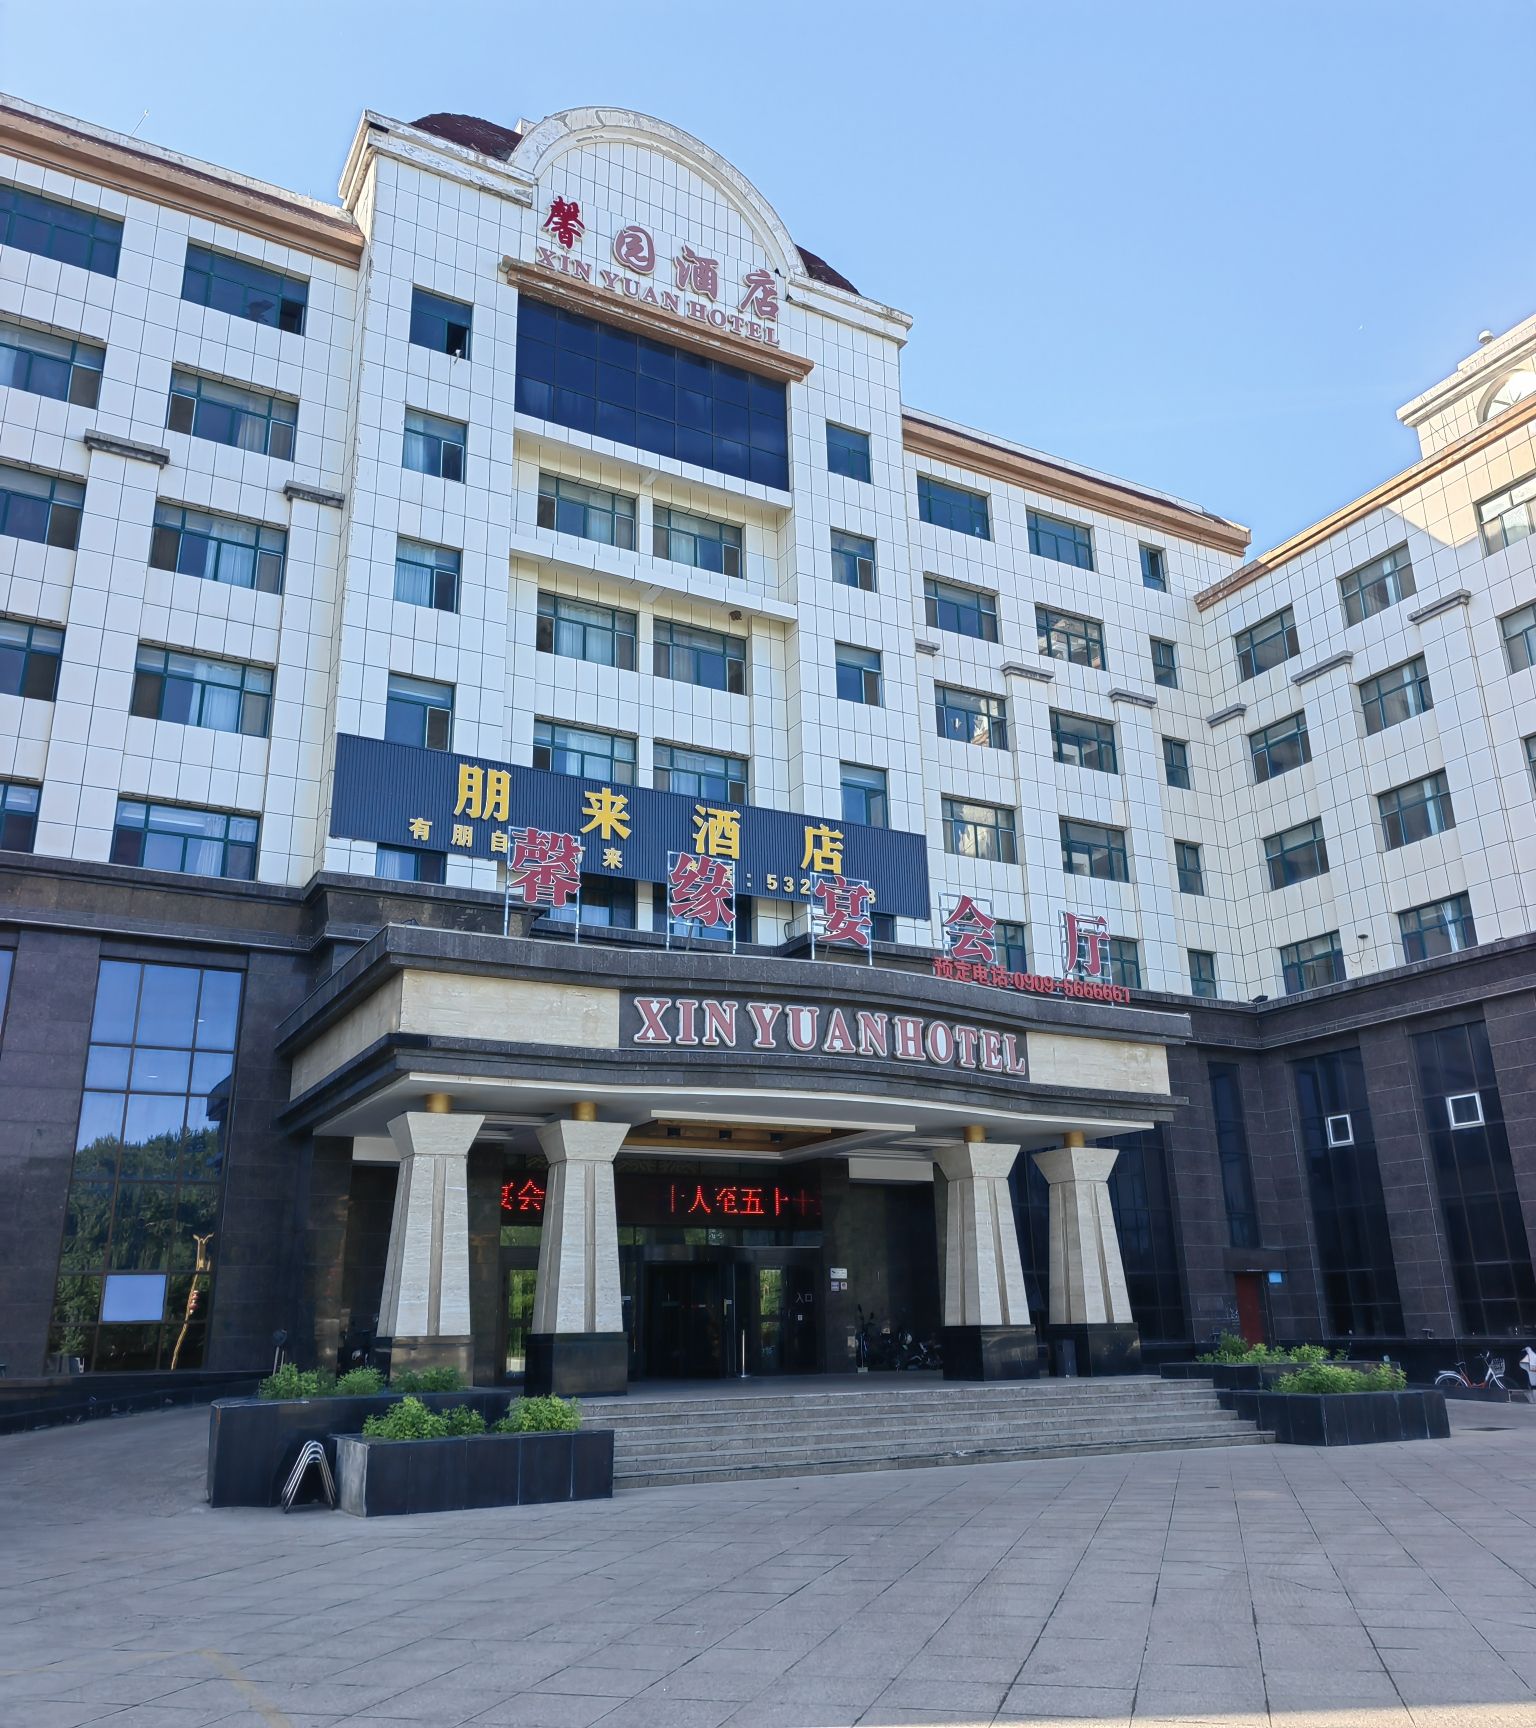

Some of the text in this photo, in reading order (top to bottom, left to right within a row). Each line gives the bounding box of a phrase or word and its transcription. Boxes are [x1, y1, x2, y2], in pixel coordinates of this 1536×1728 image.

[536, 246, 780, 348] XIN YUAN HOTEL
[453, 763, 844, 875] 朋来酒店
